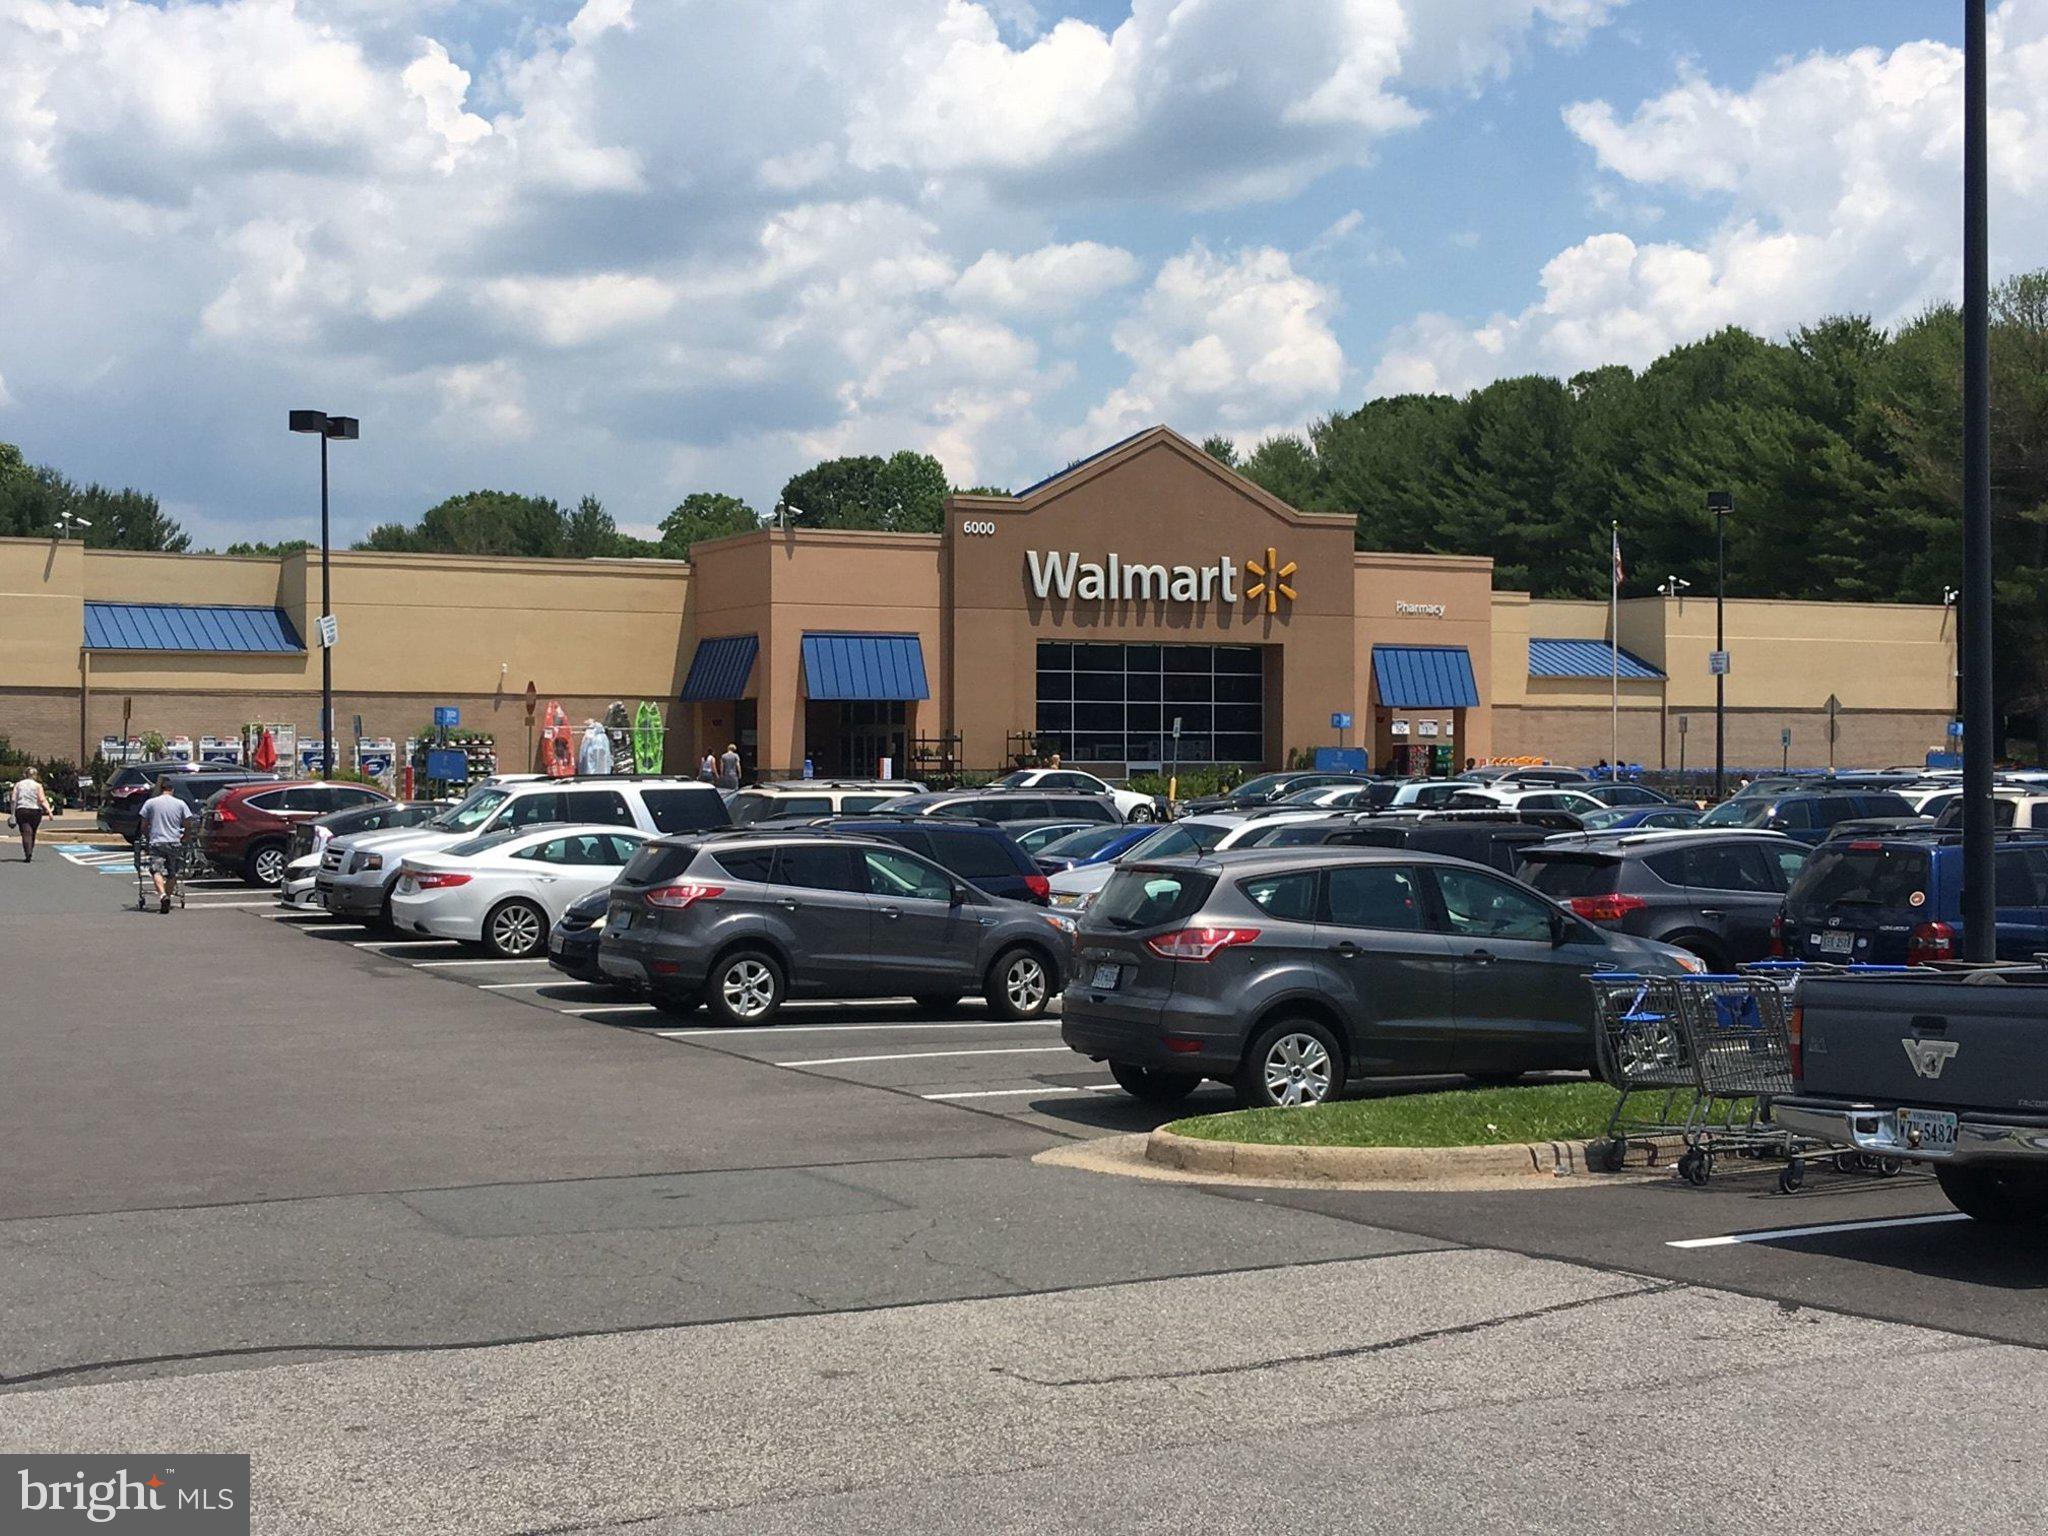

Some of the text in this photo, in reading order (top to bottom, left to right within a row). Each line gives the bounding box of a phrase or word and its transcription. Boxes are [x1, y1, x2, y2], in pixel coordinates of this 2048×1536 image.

[963, 520, 995, 535] 6000
[1026, 550, 1238, 602] Walmart
[1396, 600, 1446, 616] Pharmacy
